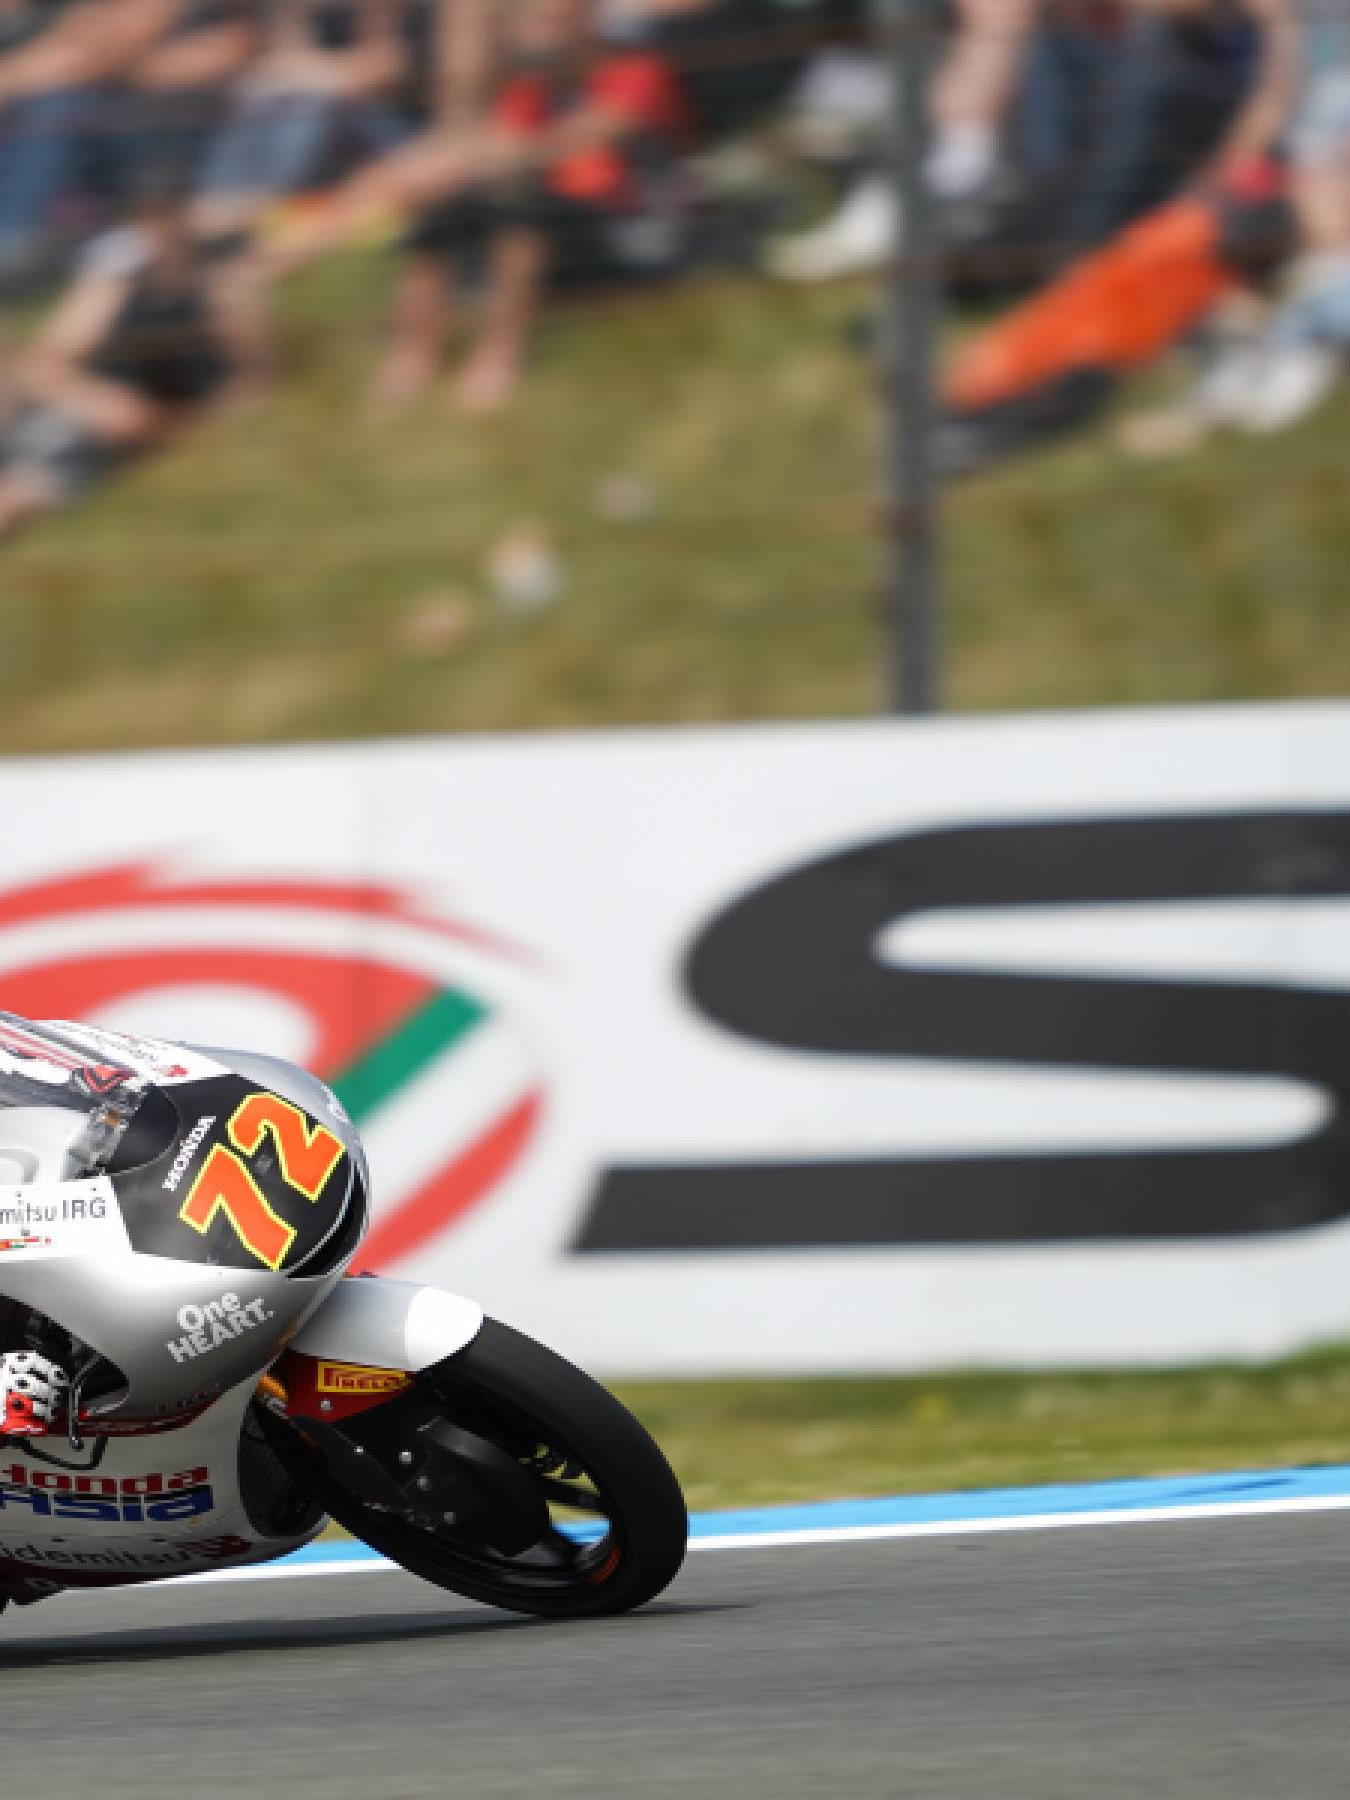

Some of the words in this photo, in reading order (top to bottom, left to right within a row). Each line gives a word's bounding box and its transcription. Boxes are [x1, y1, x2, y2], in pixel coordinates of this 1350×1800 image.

[162, 1116, 216, 1191] HONDA
[179, 1091, 347, 1272] 72
[61, 1196, 107, 1220] IRG
[165, 1296, 274, 1363] HEART.
[176, 1291, 240, 1332] One
